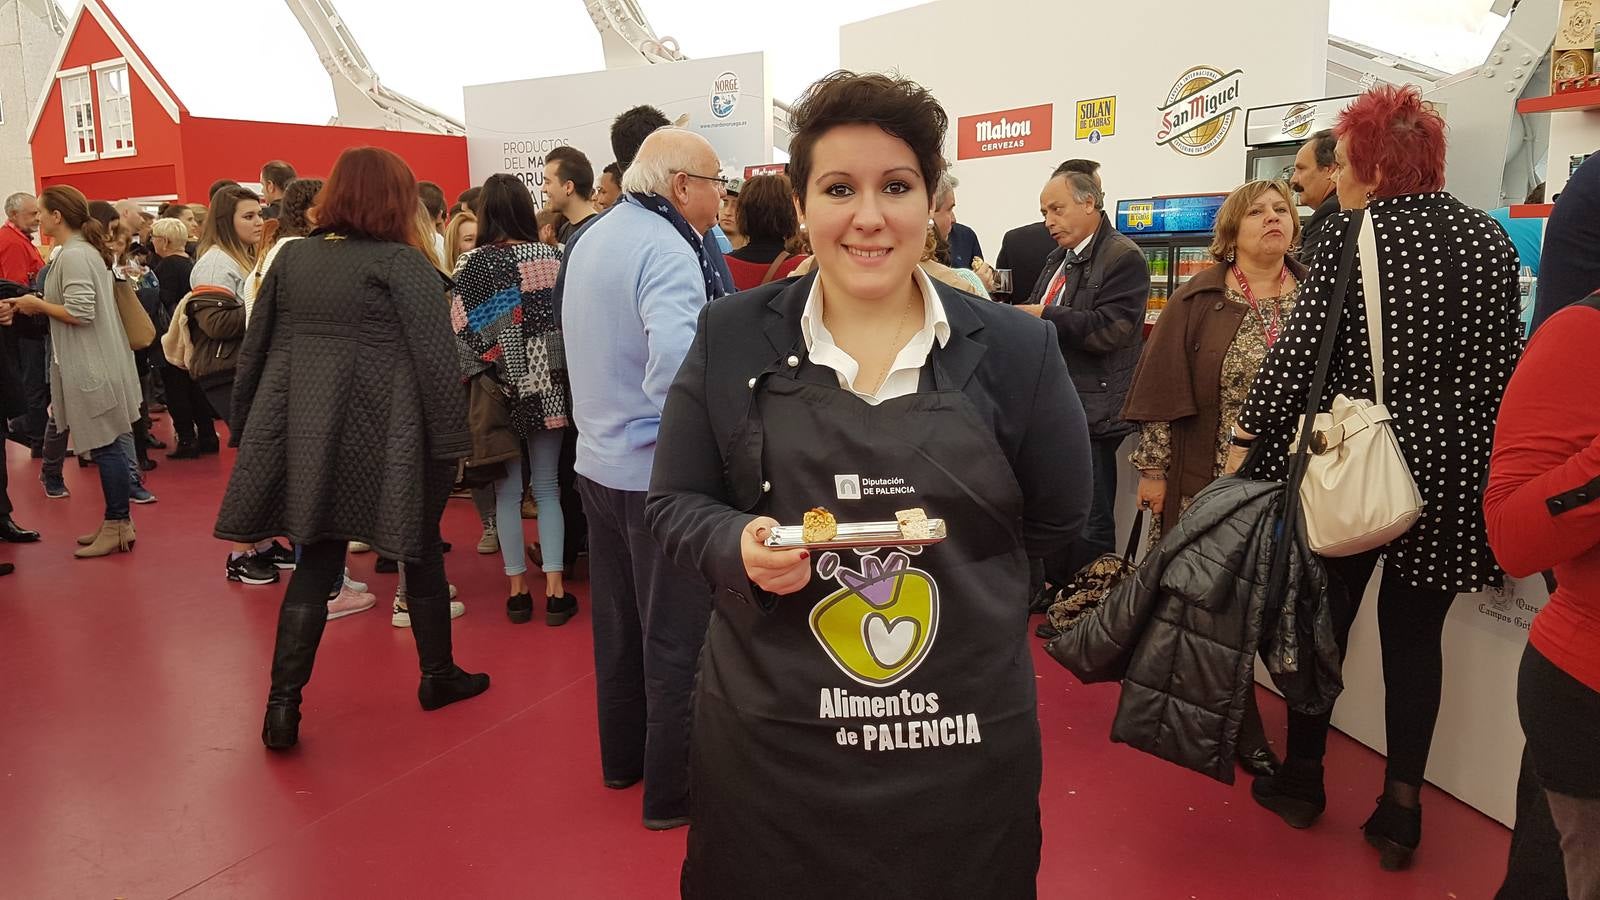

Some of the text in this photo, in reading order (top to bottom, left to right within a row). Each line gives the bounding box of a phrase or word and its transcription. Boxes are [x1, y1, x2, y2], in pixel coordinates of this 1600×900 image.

[714, 78, 739, 92] NORGE
[1157, 79, 1239, 139] San Miguel
[975, 117, 1031, 142] Mahou
[1088, 117, 1111, 128] CABRAS
[503, 138, 569, 154] PRODUCTOS
[981, 139, 1025, 152] CERVEZAS
[504, 156, 545, 170] DEL MA
[862, 477, 905, 486] Diputación
[875, 486, 916, 495] PALENCIA
[1516, 598, 1541, 614] Ques
[1478, 603, 1531, 631] Campos Gót
[819, 687, 940, 719] Alimentos
[836, 713, 982, 751] de PALENCIA
